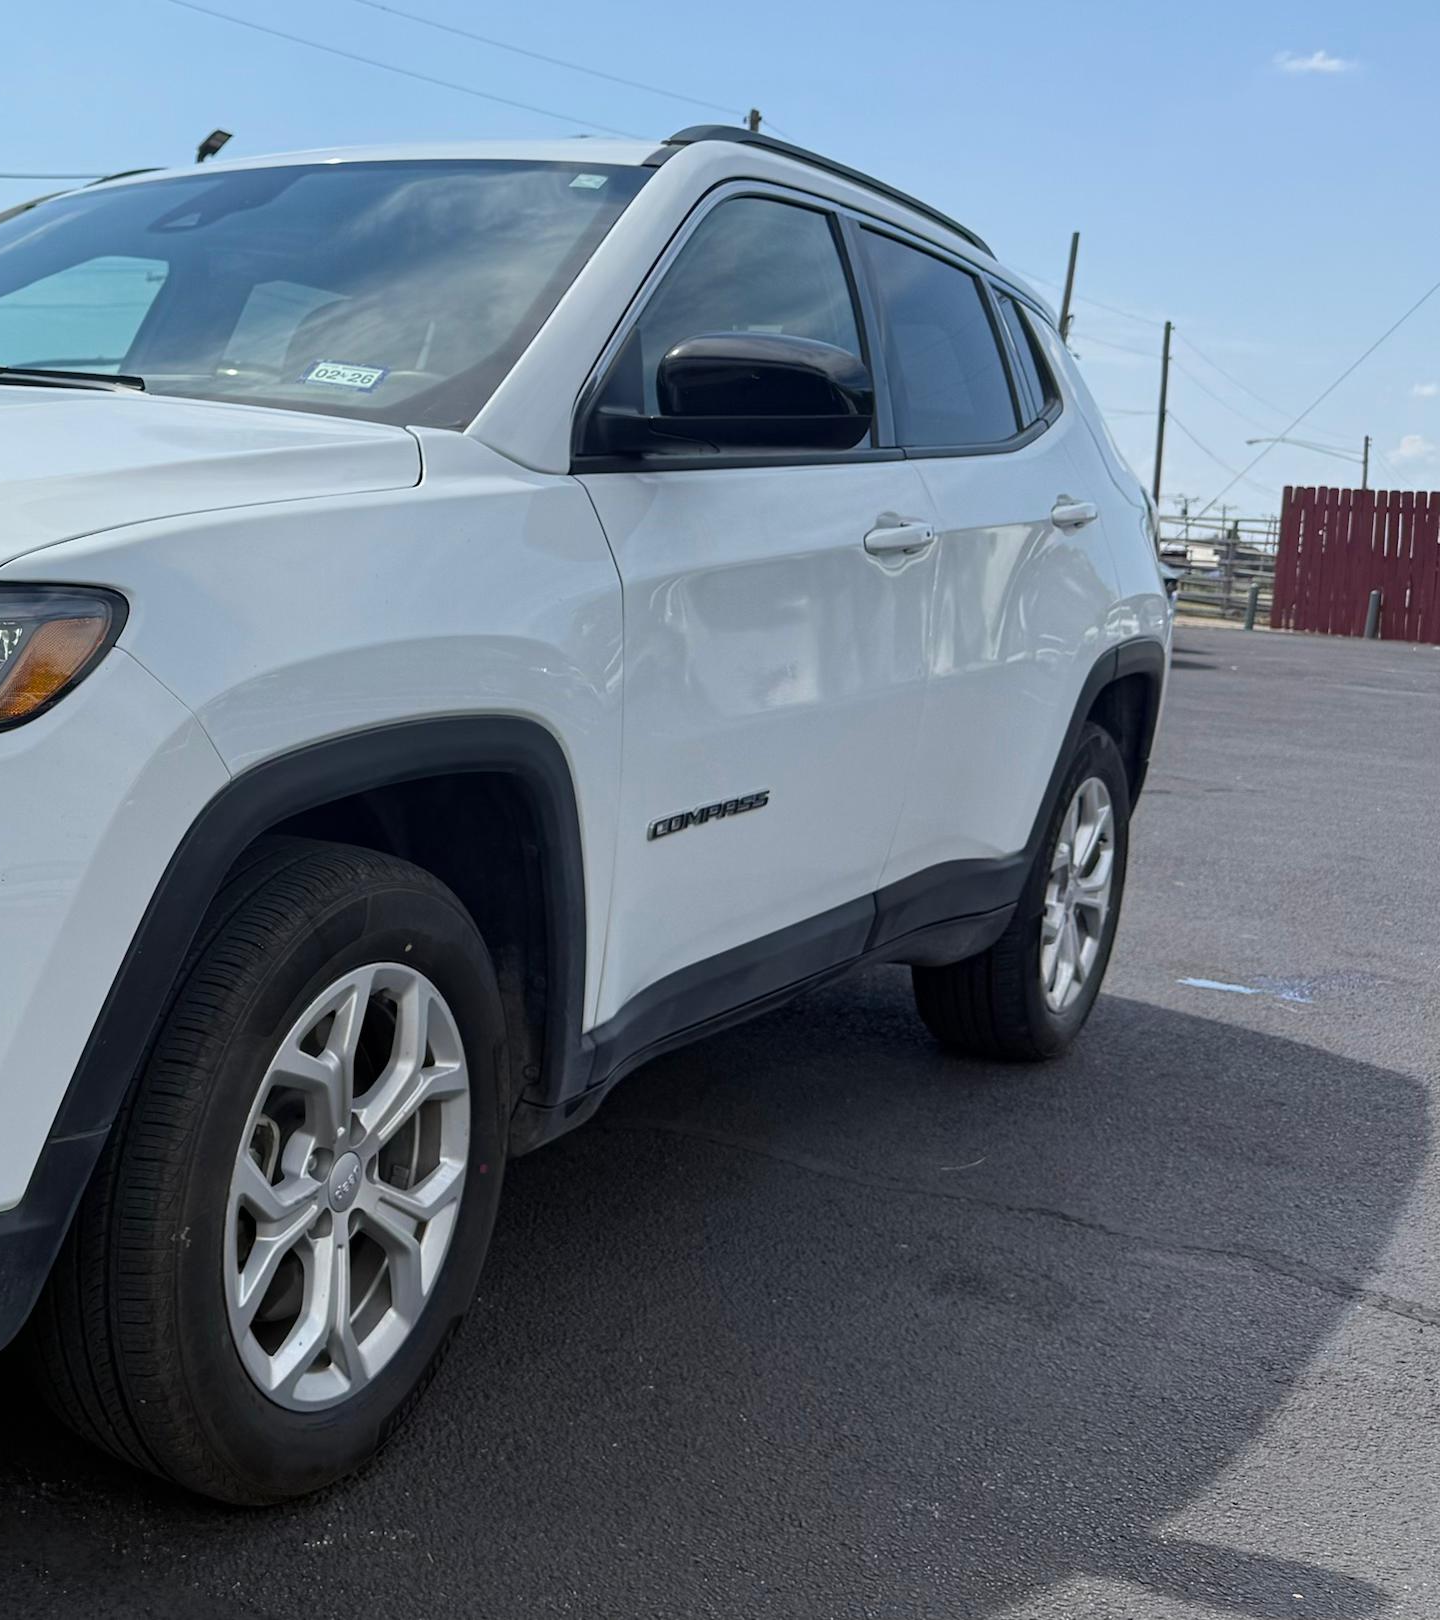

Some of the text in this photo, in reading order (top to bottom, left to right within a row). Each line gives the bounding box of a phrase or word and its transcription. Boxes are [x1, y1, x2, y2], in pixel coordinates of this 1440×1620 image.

[315, 368, 340, 380] 02
[347, 373, 374, 384] 26
[647, 790, 770, 841] COMPASS
